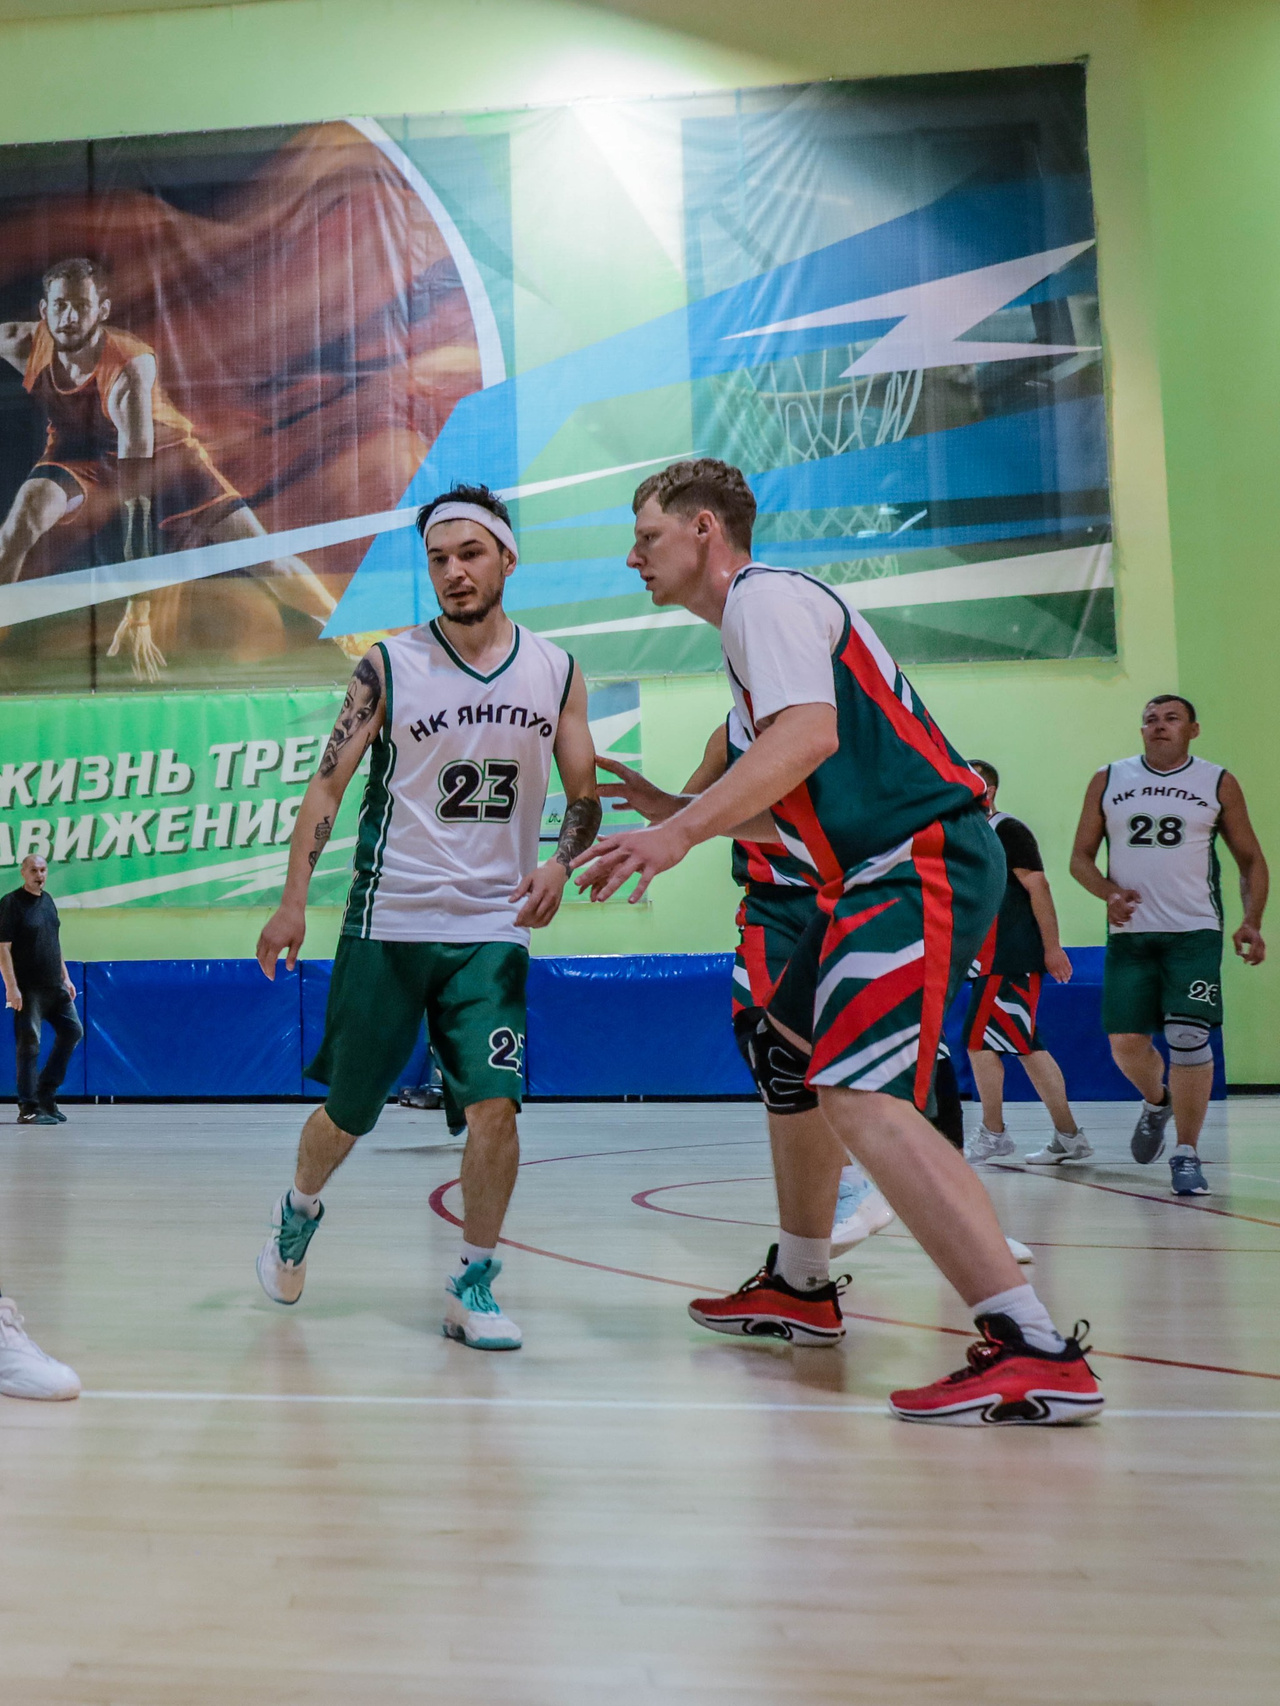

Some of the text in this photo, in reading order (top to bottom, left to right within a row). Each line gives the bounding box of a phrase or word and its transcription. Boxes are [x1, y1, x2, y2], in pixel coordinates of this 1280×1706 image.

[410, 704, 553, 742] НК ЯНГПУР
[436, 759, 519, 823] 23
[1112, 786, 1209, 808] НК ЯНГПУР
[1127, 813, 1185, 848] 28
